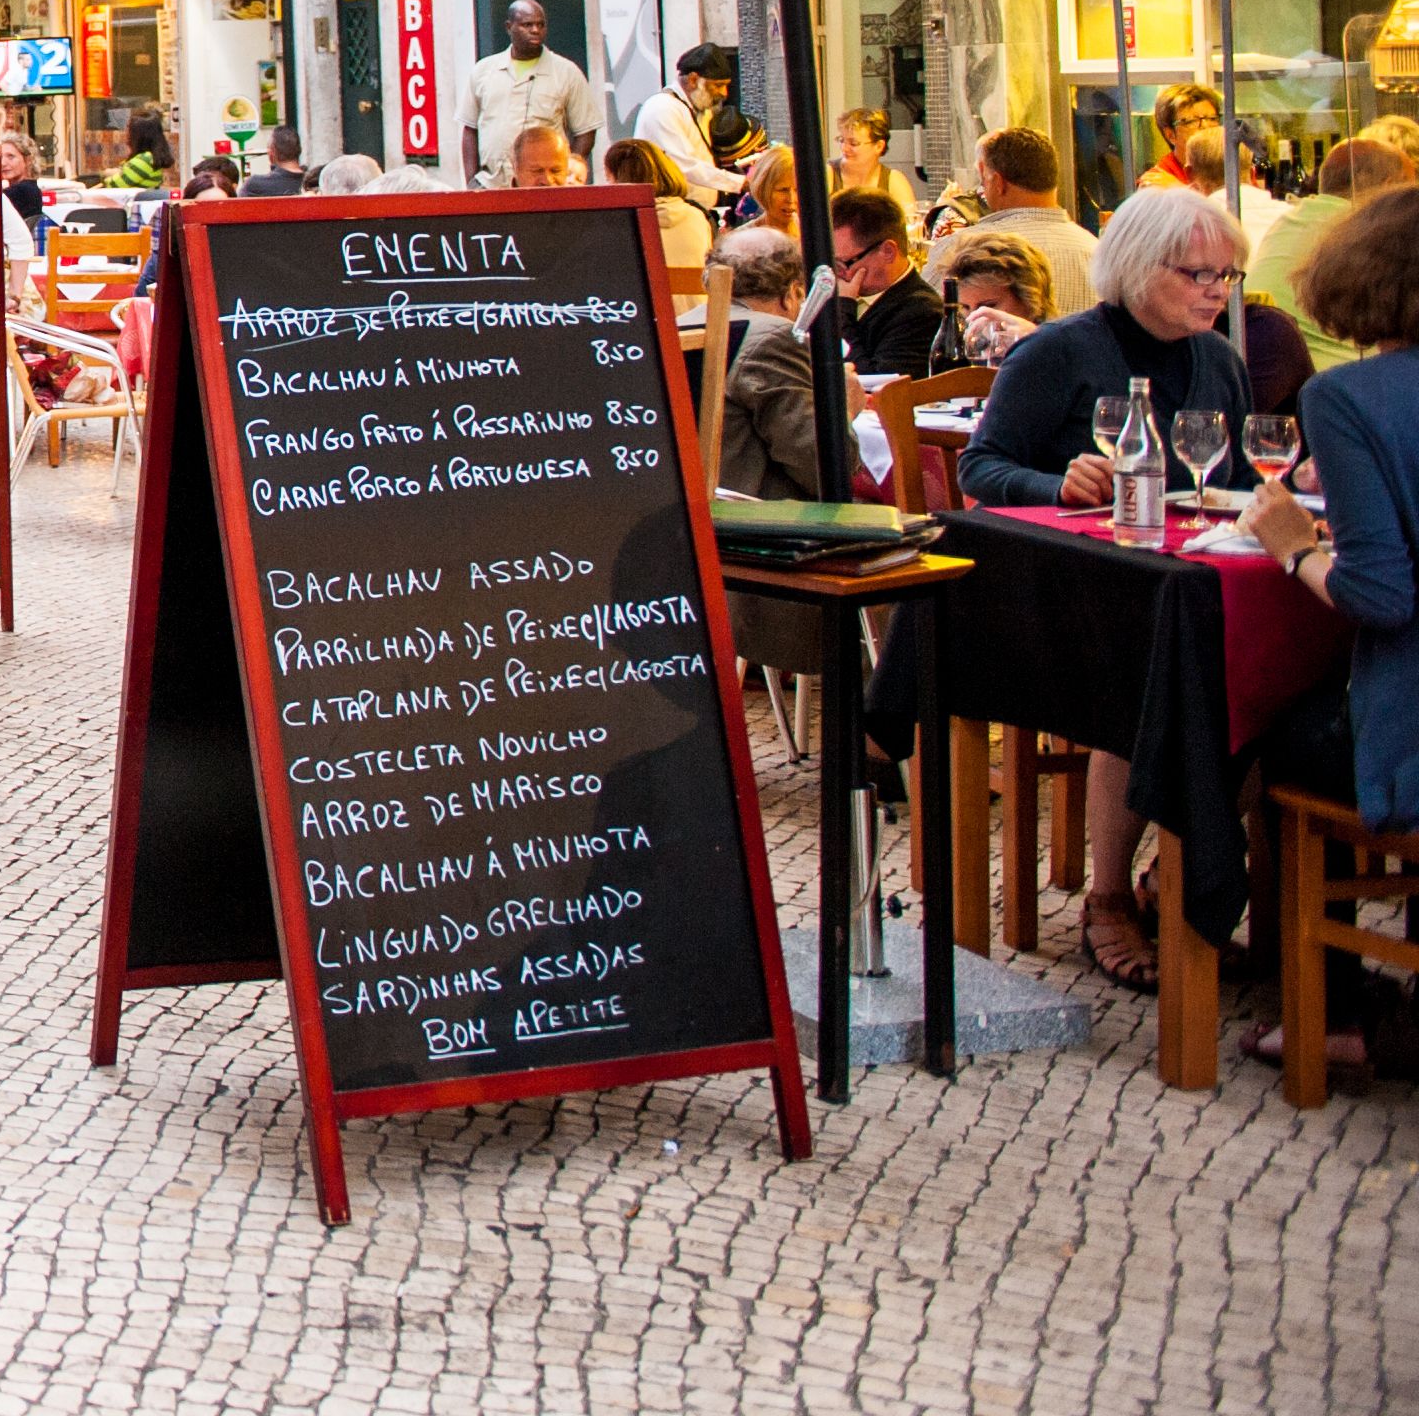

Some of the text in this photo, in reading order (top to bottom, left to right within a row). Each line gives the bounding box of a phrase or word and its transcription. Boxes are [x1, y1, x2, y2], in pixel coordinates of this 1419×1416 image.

[341, 232, 526, 276] EMENTA
[232, 298, 340, 339] ARROZ
[237, 358, 386, 398] BACALHAU
[245, 418, 355, 460] FRANGO
[252, 477, 346, 516] CARNE
[348, 464, 421, 503] PORCO
[447, 455, 592, 492] PORTUGUESA
[468, 550, 595, 590] ASSADO
[462, 622, 496, 660] DE
[282, 683, 451, 728] CATAPLANA
[459, 677, 496, 717] DE
[289, 744, 465, 784] COSTELETA
[301, 799, 410, 841] ARROZ
[424, 792, 465, 826] DE
[486, 885, 643, 938] GRELHADO
[519, 942, 645, 986] ASSADAS
[421, 1016, 490, 1056] BOM
